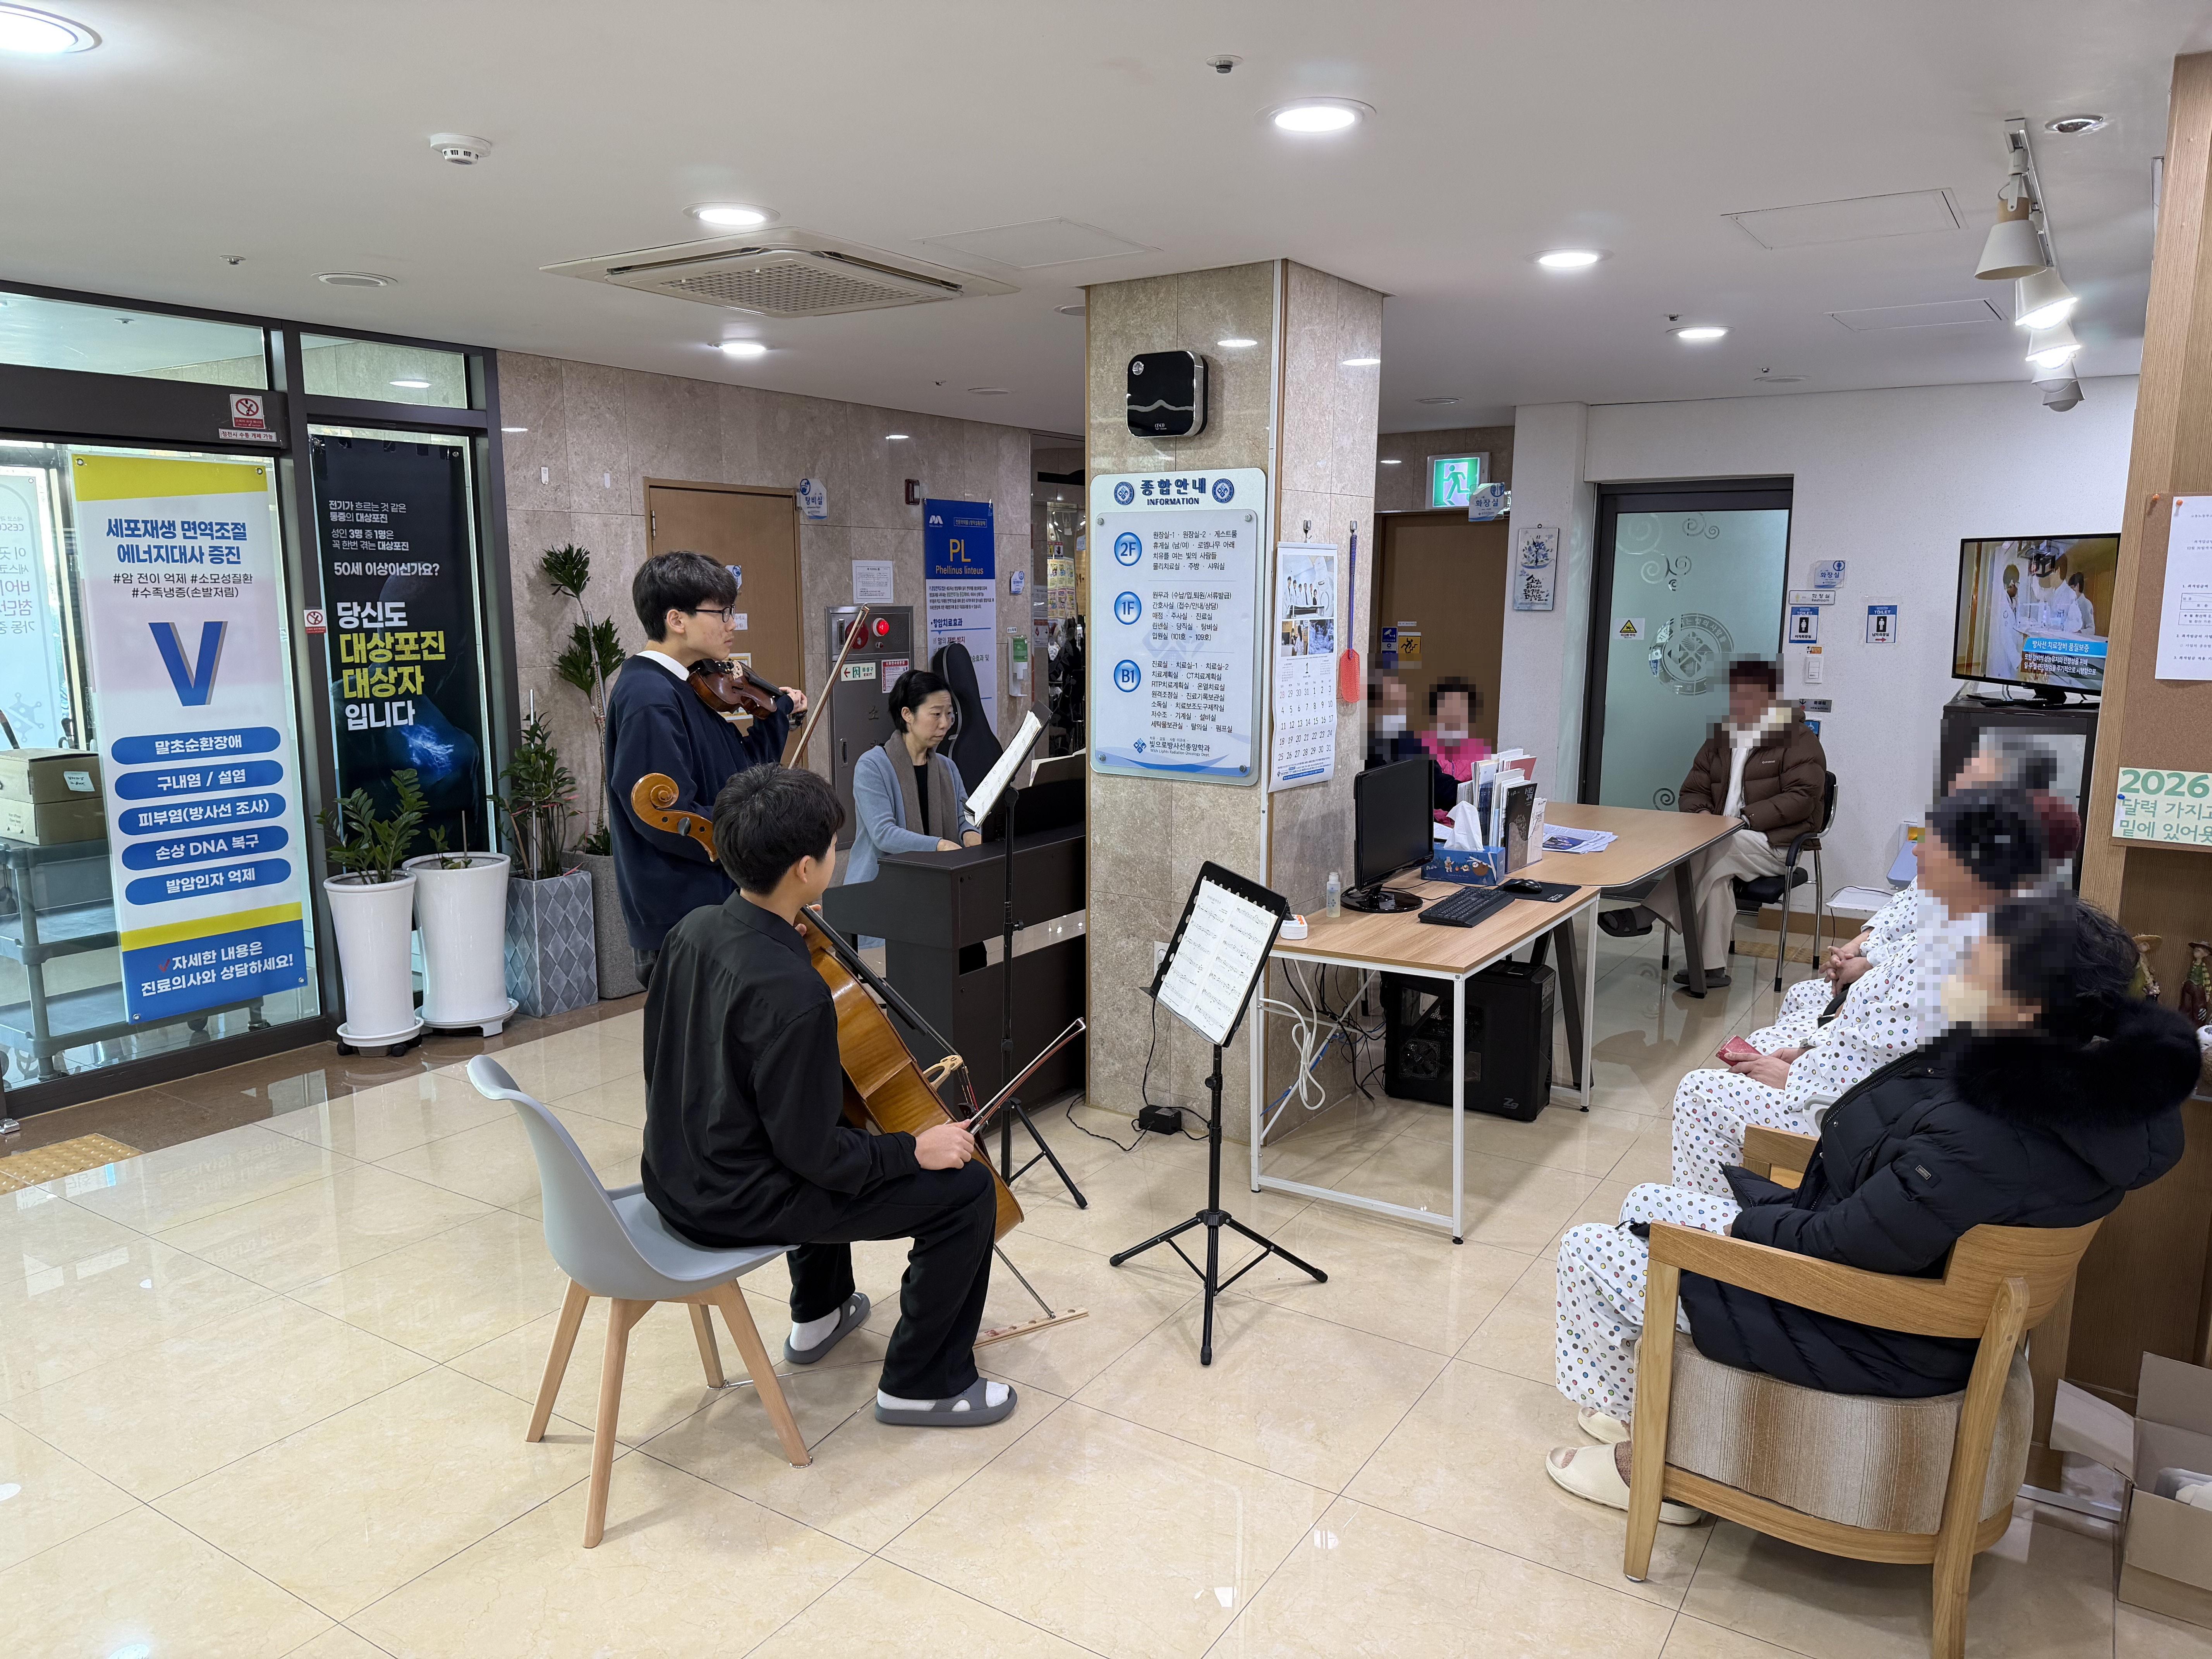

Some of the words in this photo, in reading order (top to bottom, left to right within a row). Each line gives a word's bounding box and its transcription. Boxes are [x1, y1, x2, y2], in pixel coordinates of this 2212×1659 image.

[1140, 477, 1206, 496] 종합안내
[329, 500, 354, 510] 전기가
[355, 502, 379, 512] 흐르는
[381, 503, 389, 512] 것
[390, 503, 406, 513] 같은
[805, 496, 822, 505] 탕비실
[1475, 499, 1498, 507] 화장실
[330, 512, 354, 522] 통증의
[356, 513, 388, 523] 대상포진
[106, 519, 176, 539] 세포재생
[181, 520, 247, 541] 면역조절
[331, 529, 347, 538] 성인
[349, 529, 362, 539] 3명
[365, 530, 373, 539] 중
[374, 530, 394, 539] 1명은
[332, 540, 340, 550] 꼭
[342, 540, 358, 550] 한번
[360, 541, 376, 550] 겪는
[378, 541, 409, 551] 대상포진
[950, 539, 971, 562] PL
[1120, 542, 1136, 556] 2F
[117, 544, 204, 564] 에너지대사
[208, 546, 241, 565] 증진
[334, 562, 362, 575] 50세
[366, 562, 440, 576] 이상이신가요?
[936, 565, 962, 574] Phellinus
[964, 565, 983, 574] linteus
[113, 573, 133, 584] #암
[137, 573, 160, 584] 전이
[164, 574, 186, 584] 억제
[191, 573, 252, 584] #소모성질환
[132, 587, 239, 598] #수족냉증(손발저림)
[1121, 601, 1134, 615] 1F
[337, 602, 408, 629] 당신도
[933, 618, 962, 628] 항암치료효과
[339, 631, 446, 664] 대상포진
[2032, 641, 2047, 649] 방사선
[2048, 642, 2067, 651] 치료장비
[2069, 643, 2089, 653] 품질보증
[148, 621, 228, 707] V
[1206, 662, 1229, 670] 치료실-2
[1305, 663, 1309, 673] 1
[342, 665, 424, 699] 대상자
[1121, 669, 1134, 683] B1
[1186, 672, 1222, 680] CT치료계획실
[1151, 681, 1189, 689] RTP치료계획실
[1197, 683, 1225, 691] 온열치료실
[1186, 692, 1225, 702] 진료기록보관실
[1175, 702, 1224, 712] 치료보조도구제작실
[345, 700, 416, 731] 입니다
[1199, 713, 1216, 721] 설비실
[1151, 721, 1183, 730] 세탁물보관실
[155, 734, 242, 755] 말초순환장애
[1150, 741, 1210, 752] 빛으로방사선종양학과
[157, 773, 201, 791] 구내염
[218, 768, 246, 785] 설염
[2119, 769, 2210, 798] 2026
[138, 803, 232, 828] 피부염(방사선
[236, 798, 270, 815] 조사)
[2122, 799, 2157, 817] 달력
[2119, 820, 2155, 838] 밑에
[156, 843, 185, 861] 손상
[190, 839, 228, 857] DNA
[232, 834, 259, 850] 복구
[166, 873, 224, 893] 발암인자
[228, 867, 256, 883] 억제
[172, 950, 216, 970] 자세한
[221, 941, 263, 960] 내용은
[141, 969, 216, 997] 진료의사와
[220, 954, 294, 980] 상담하세요!
